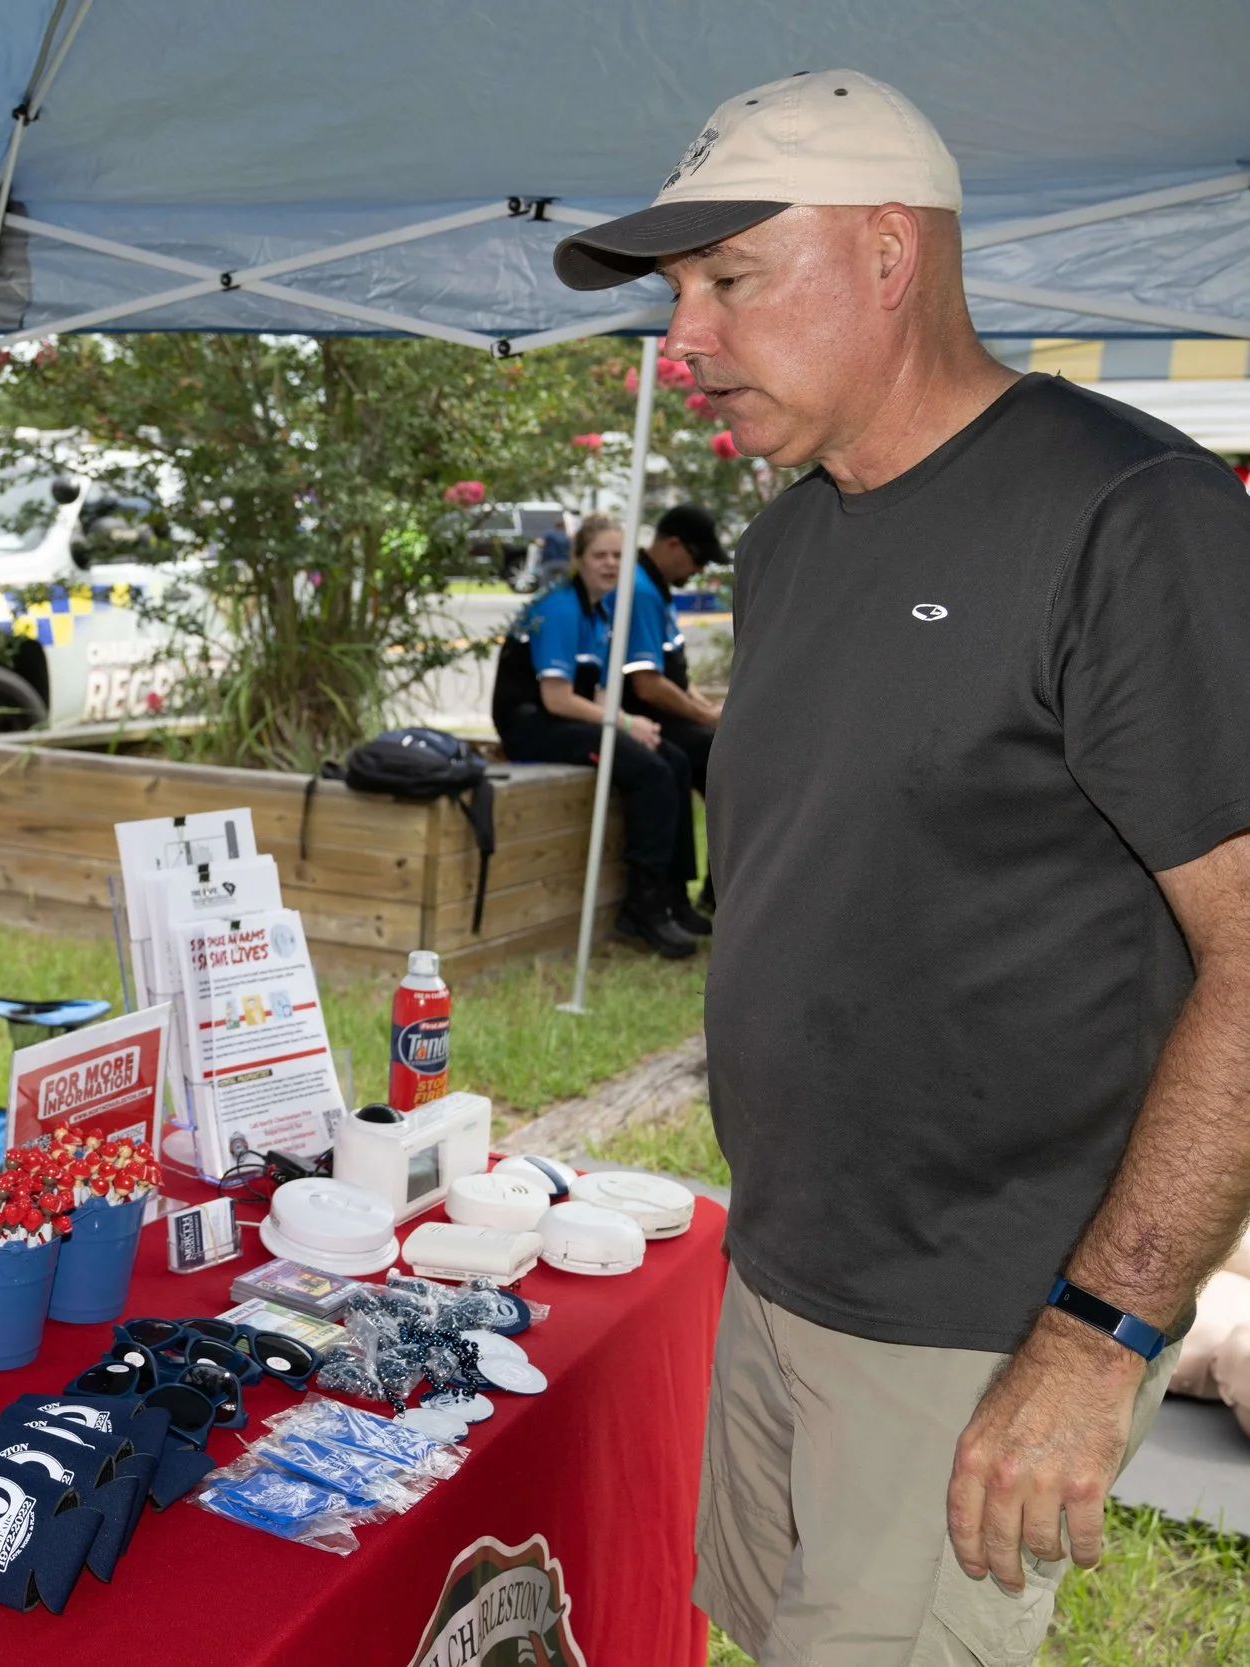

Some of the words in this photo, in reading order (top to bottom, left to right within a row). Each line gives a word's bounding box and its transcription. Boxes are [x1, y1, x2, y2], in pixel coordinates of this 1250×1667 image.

[231, 943, 269, 964] LIVES
[43, 1070, 133, 1116] INFORMATION
[44, 1072, 80, 1098] FOR
[85, 1052, 134, 1083] MORE
[447, 1581, 543, 1667] CHARLESTON
